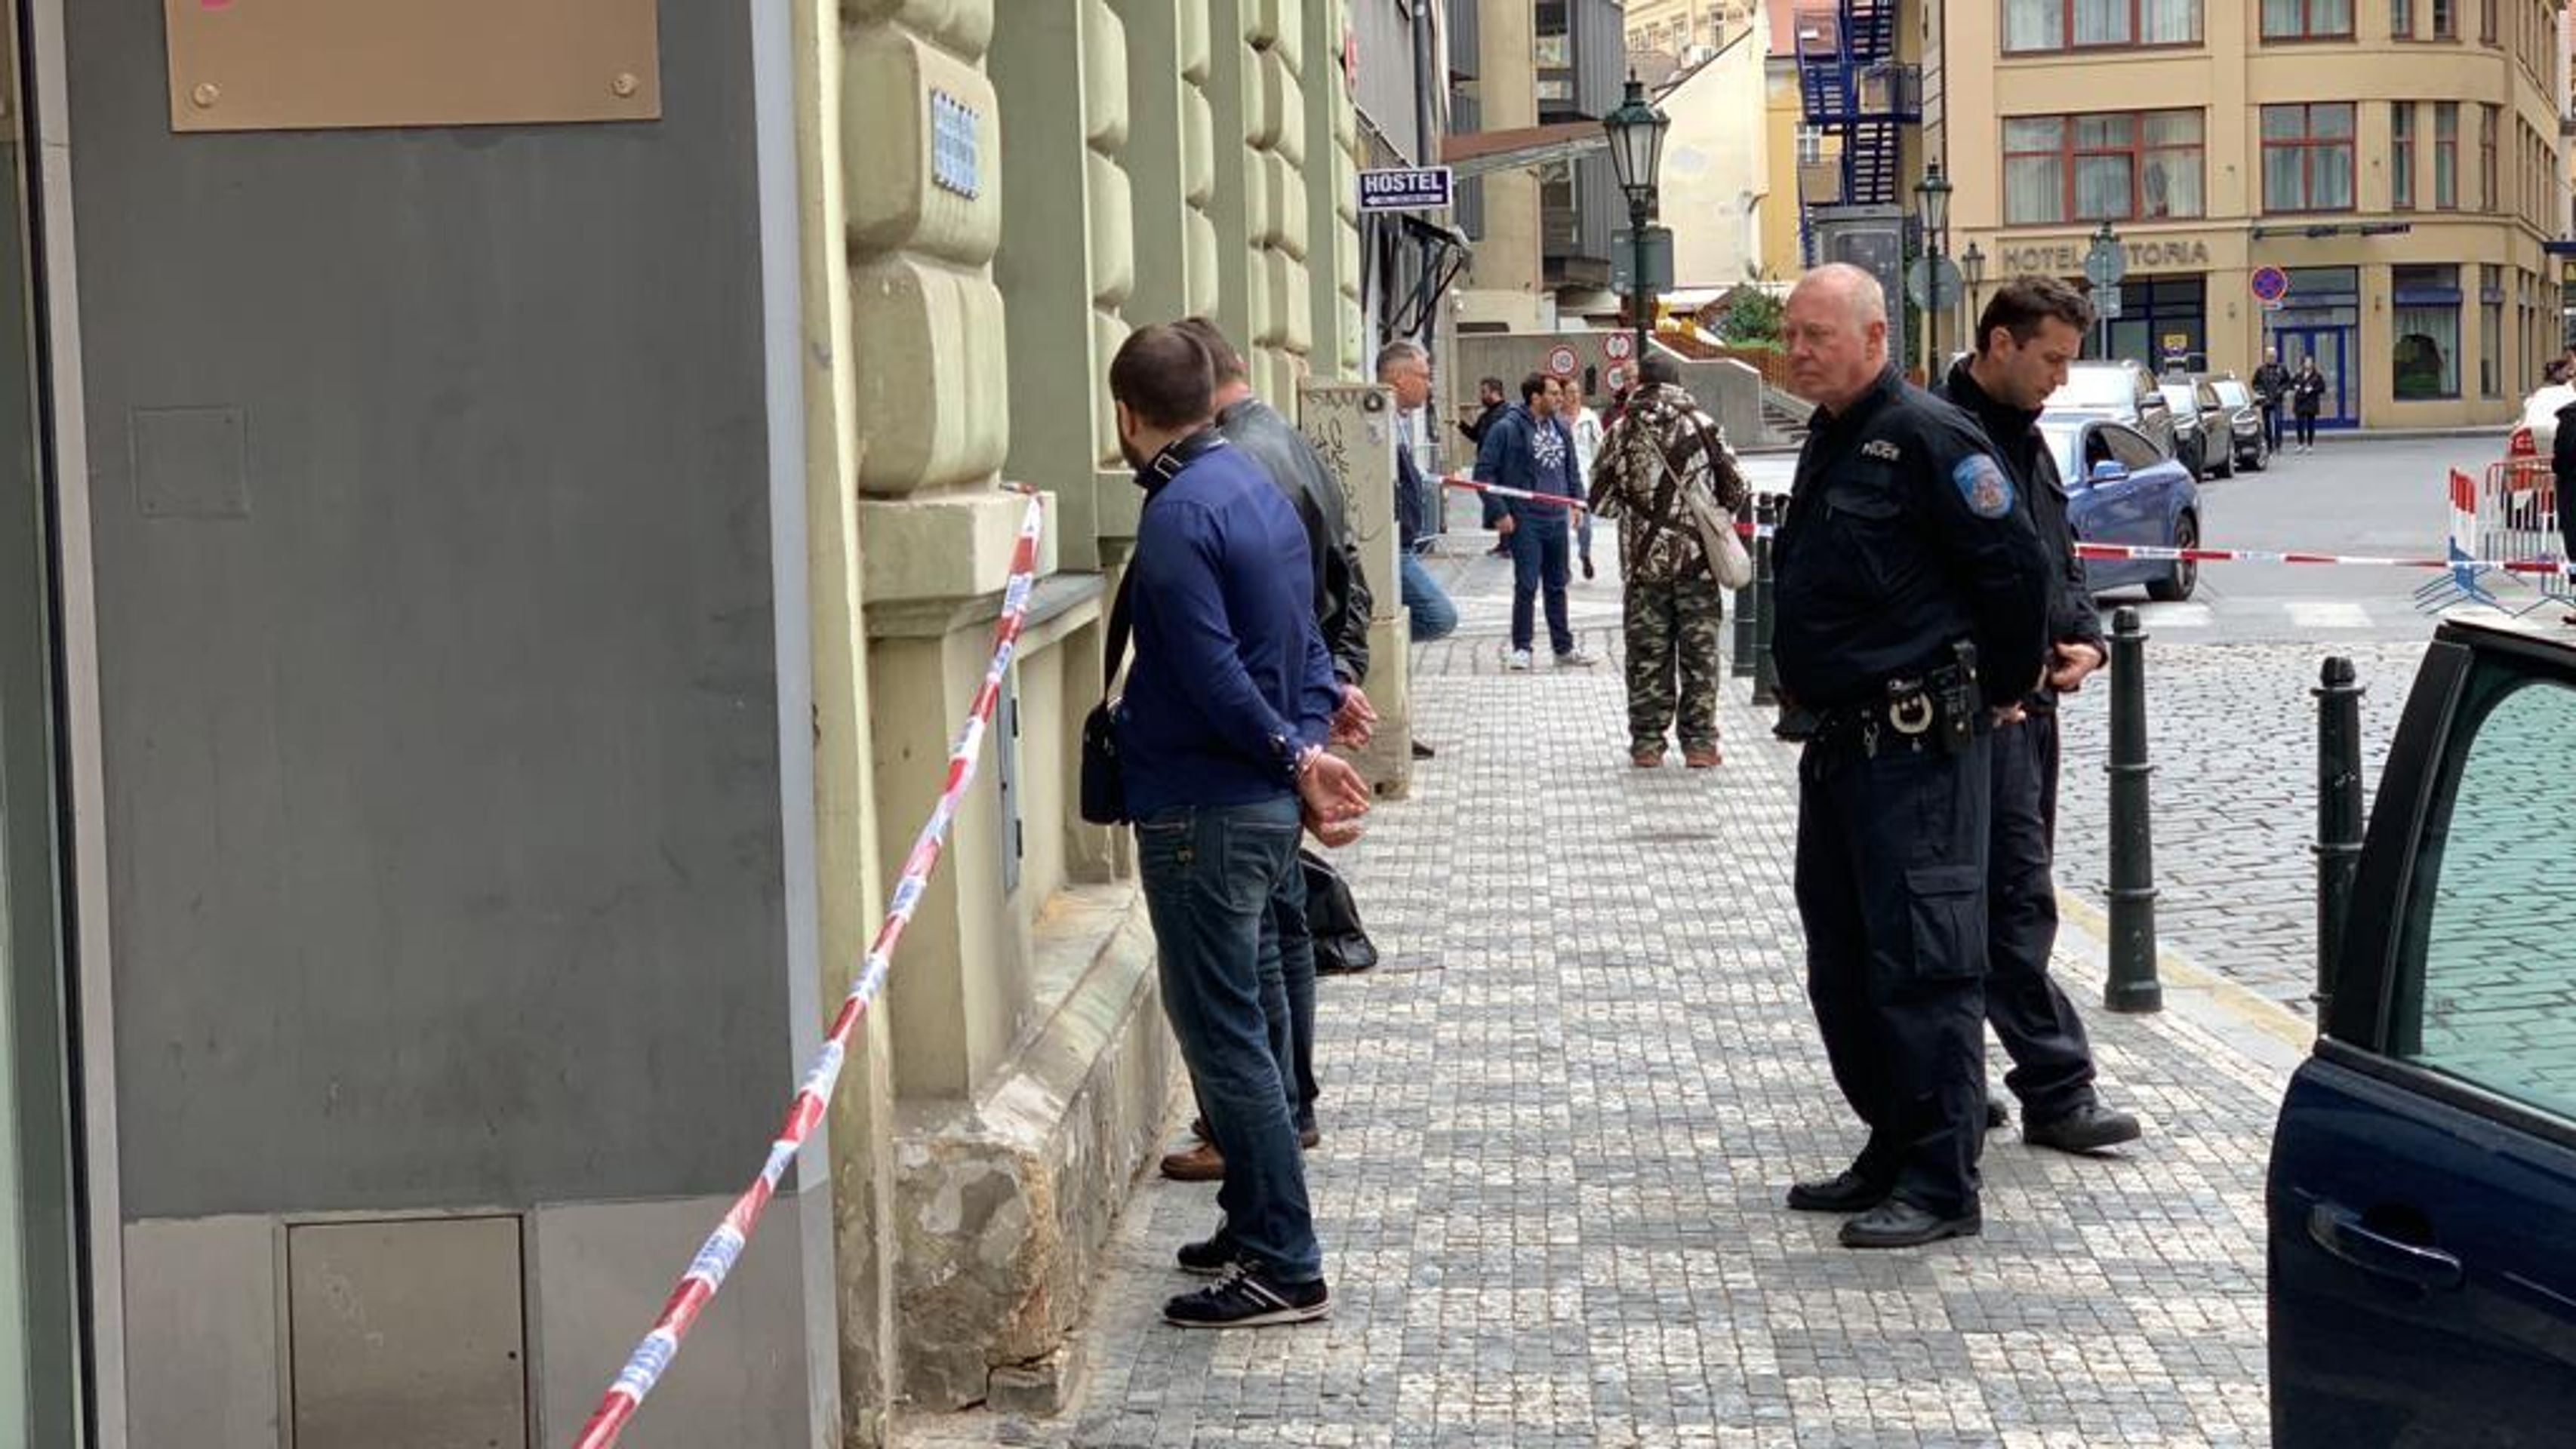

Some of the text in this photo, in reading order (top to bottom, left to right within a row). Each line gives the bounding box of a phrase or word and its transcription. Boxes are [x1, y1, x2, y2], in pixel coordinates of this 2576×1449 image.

[1364, 173, 1442, 193] HOSTEL
[2002, 237, 2210, 272] HOTEL TORIA
